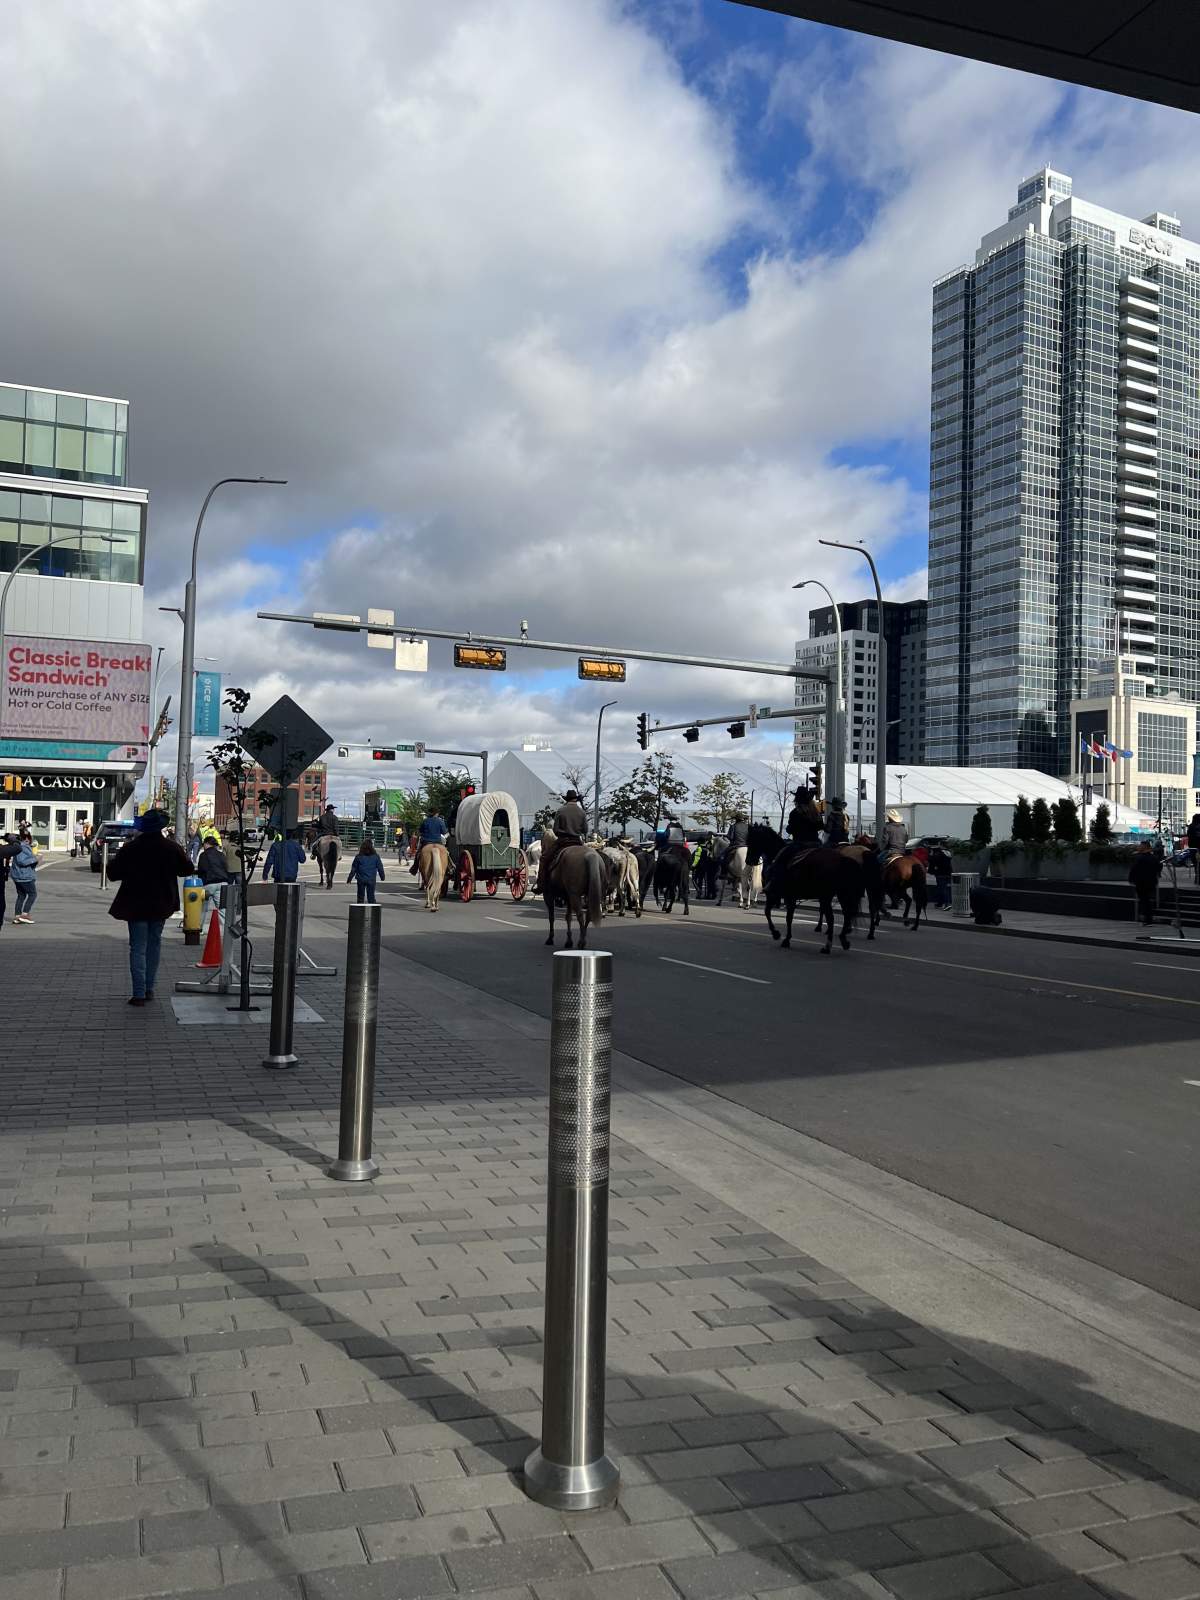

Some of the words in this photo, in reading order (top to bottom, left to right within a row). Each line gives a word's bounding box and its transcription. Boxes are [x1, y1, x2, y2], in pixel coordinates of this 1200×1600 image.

[8, 647, 81, 667] Classic
[8, 687, 34, 697] With
[36, 689, 88, 701] purchase
[92, 691, 102, 701] of
[104, 692, 127, 701] ANY
[8, 698, 28, 708] Hot
[31, 700, 43, 708] or
[46, 700, 71, 711] Cold
[74, 702, 112, 712] Coffee
[39, 775, 106, 789] CASINO
